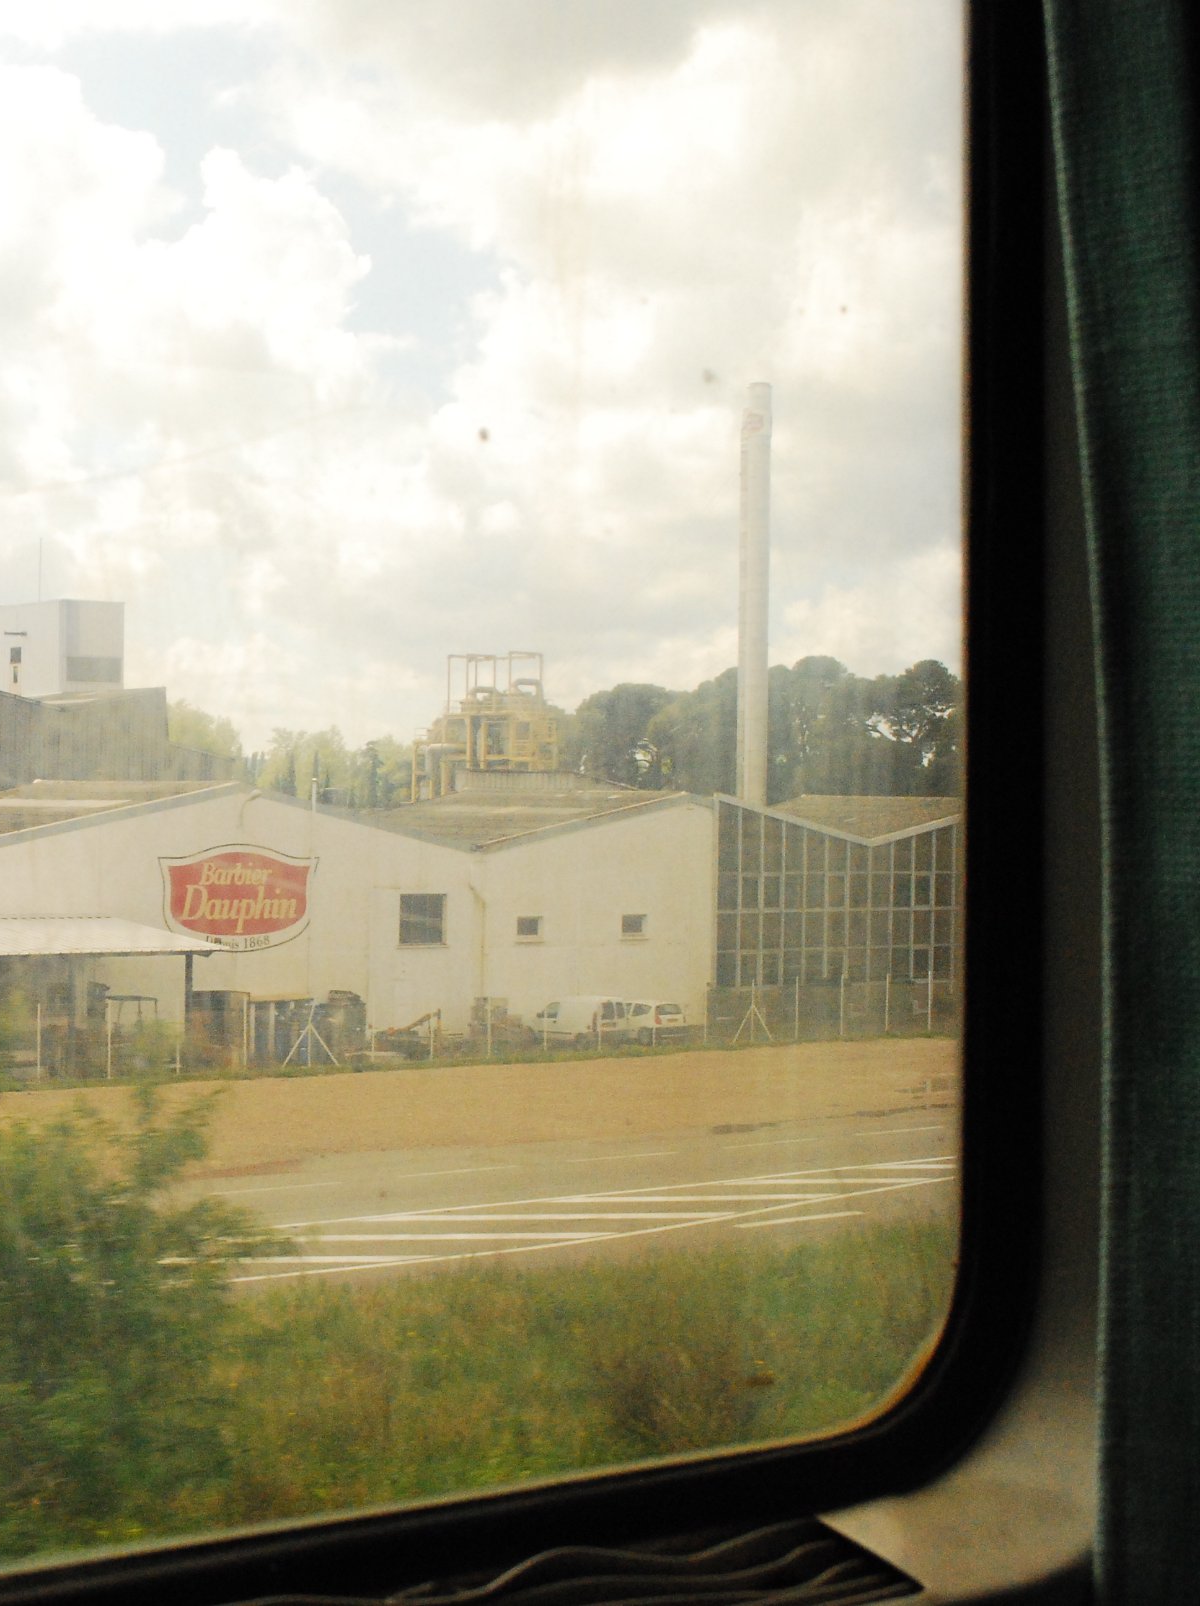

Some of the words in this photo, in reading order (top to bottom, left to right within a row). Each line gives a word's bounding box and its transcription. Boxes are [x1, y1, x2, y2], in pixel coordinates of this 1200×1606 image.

[199, 860, 273, 886] Barbier
[180, 885, 298, 934] Dauphin
[244, 935, 271, 949] 1868
